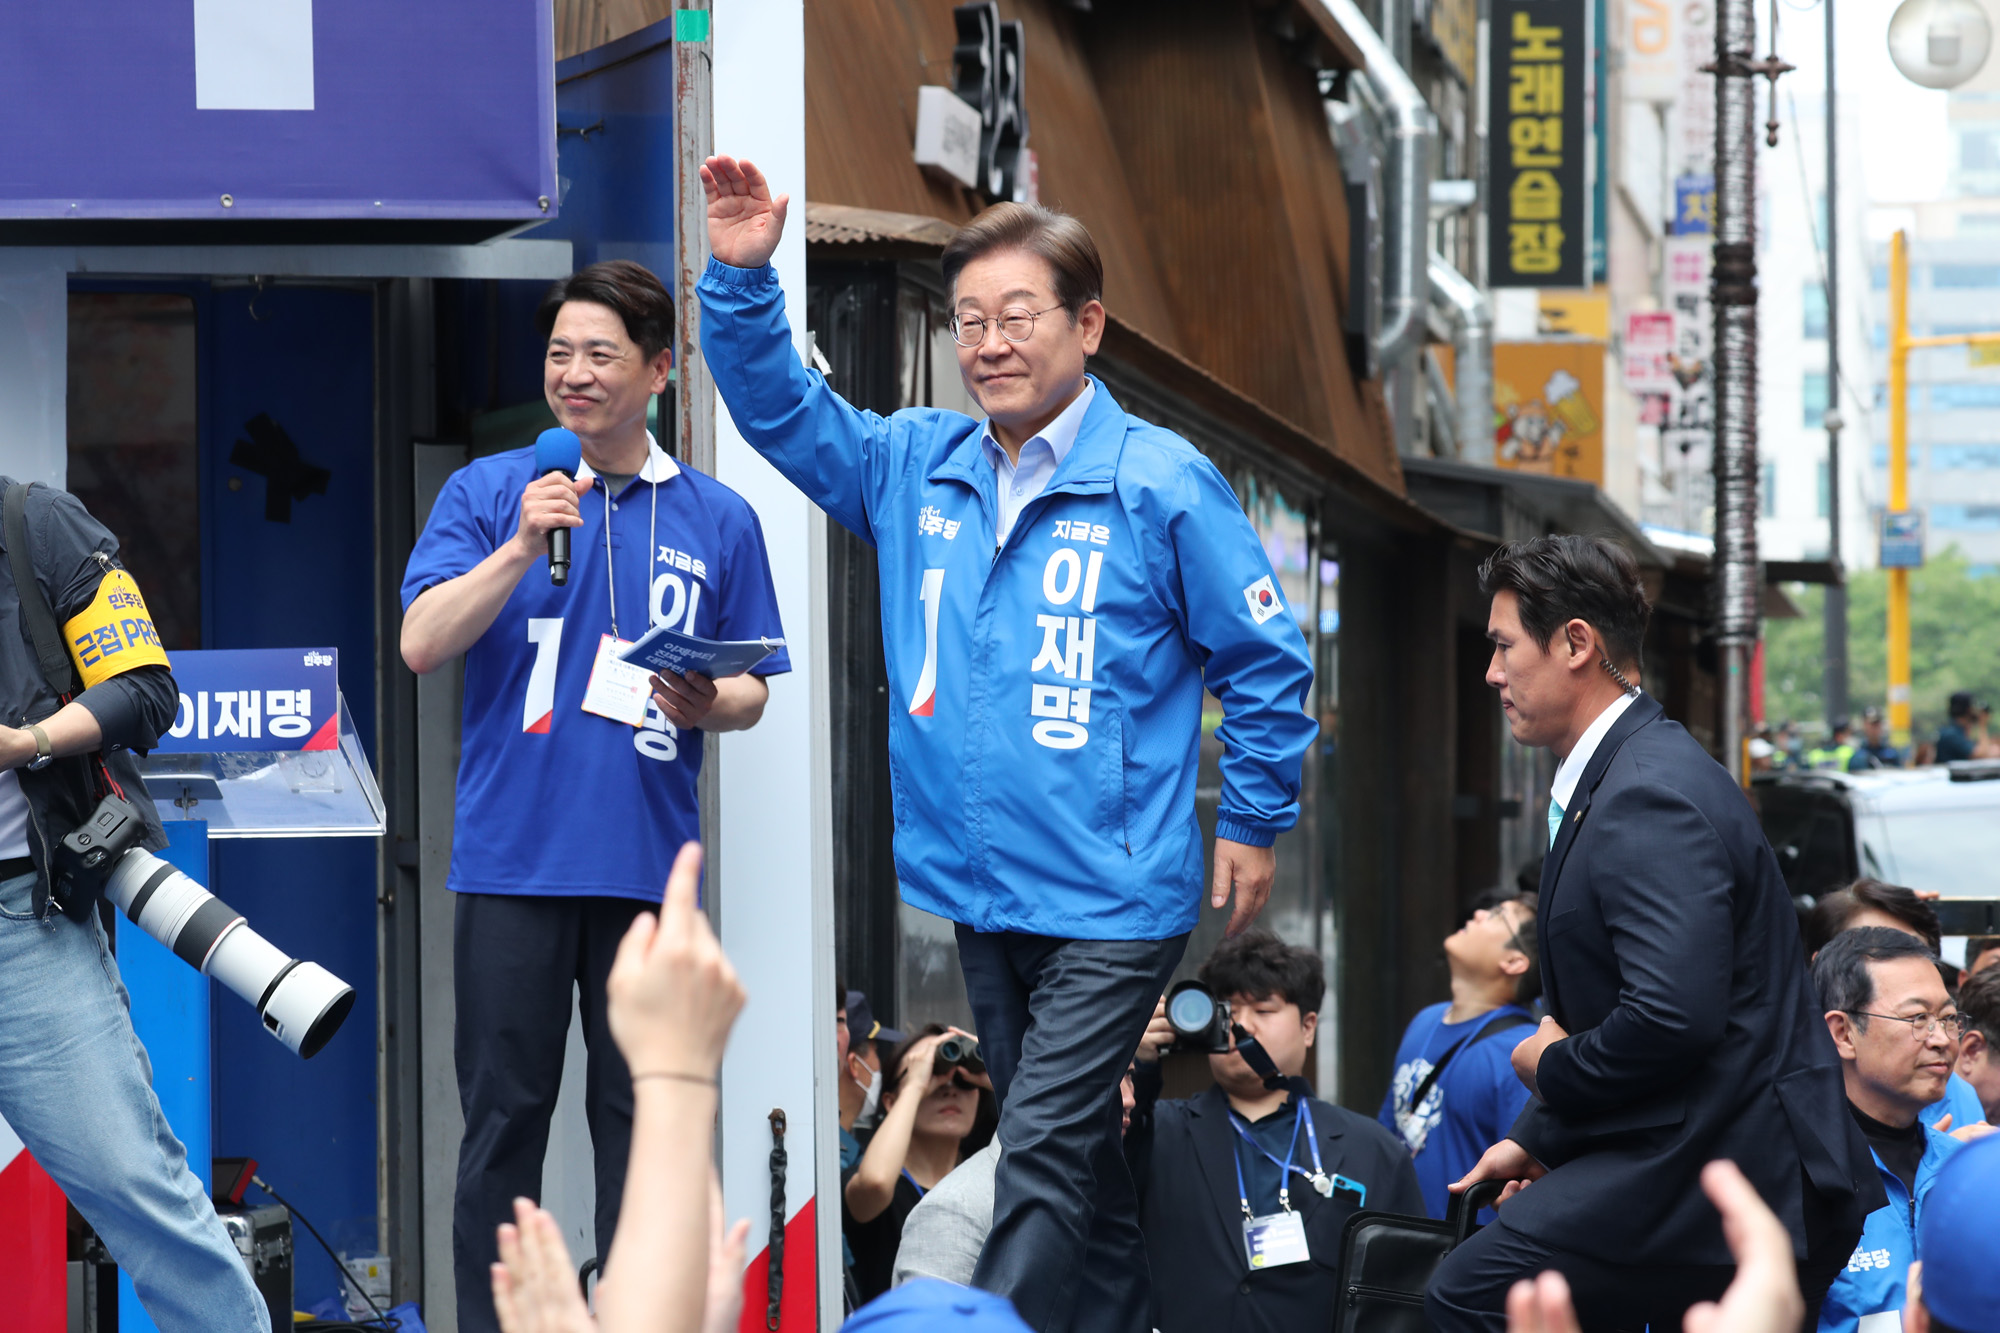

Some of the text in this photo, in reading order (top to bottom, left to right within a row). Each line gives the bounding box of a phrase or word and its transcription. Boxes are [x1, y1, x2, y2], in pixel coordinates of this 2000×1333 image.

[1508, 11, 1566, 274] 노래연습장
[1052, 520, 1110, 546] 지금은
[657, 545, 707, 580] 지금은
[107, 592, 144, 611] 민주당
[75, 623, 124, 669] 근접
[303, 654, 333, 667] 민주당
[654, 649, 683, 663] 진짜
[664, 643, 717, 662] 이제부터
[908, 568, 946, 717] 1
[1030, 547, 1104, 750] 이재명
[522, 617, 565, 734] 1
[633, 572, 701, 762] 이명
[645, 655, 688, 675] 대한민
[167, 689, 312, 740] 이재명
